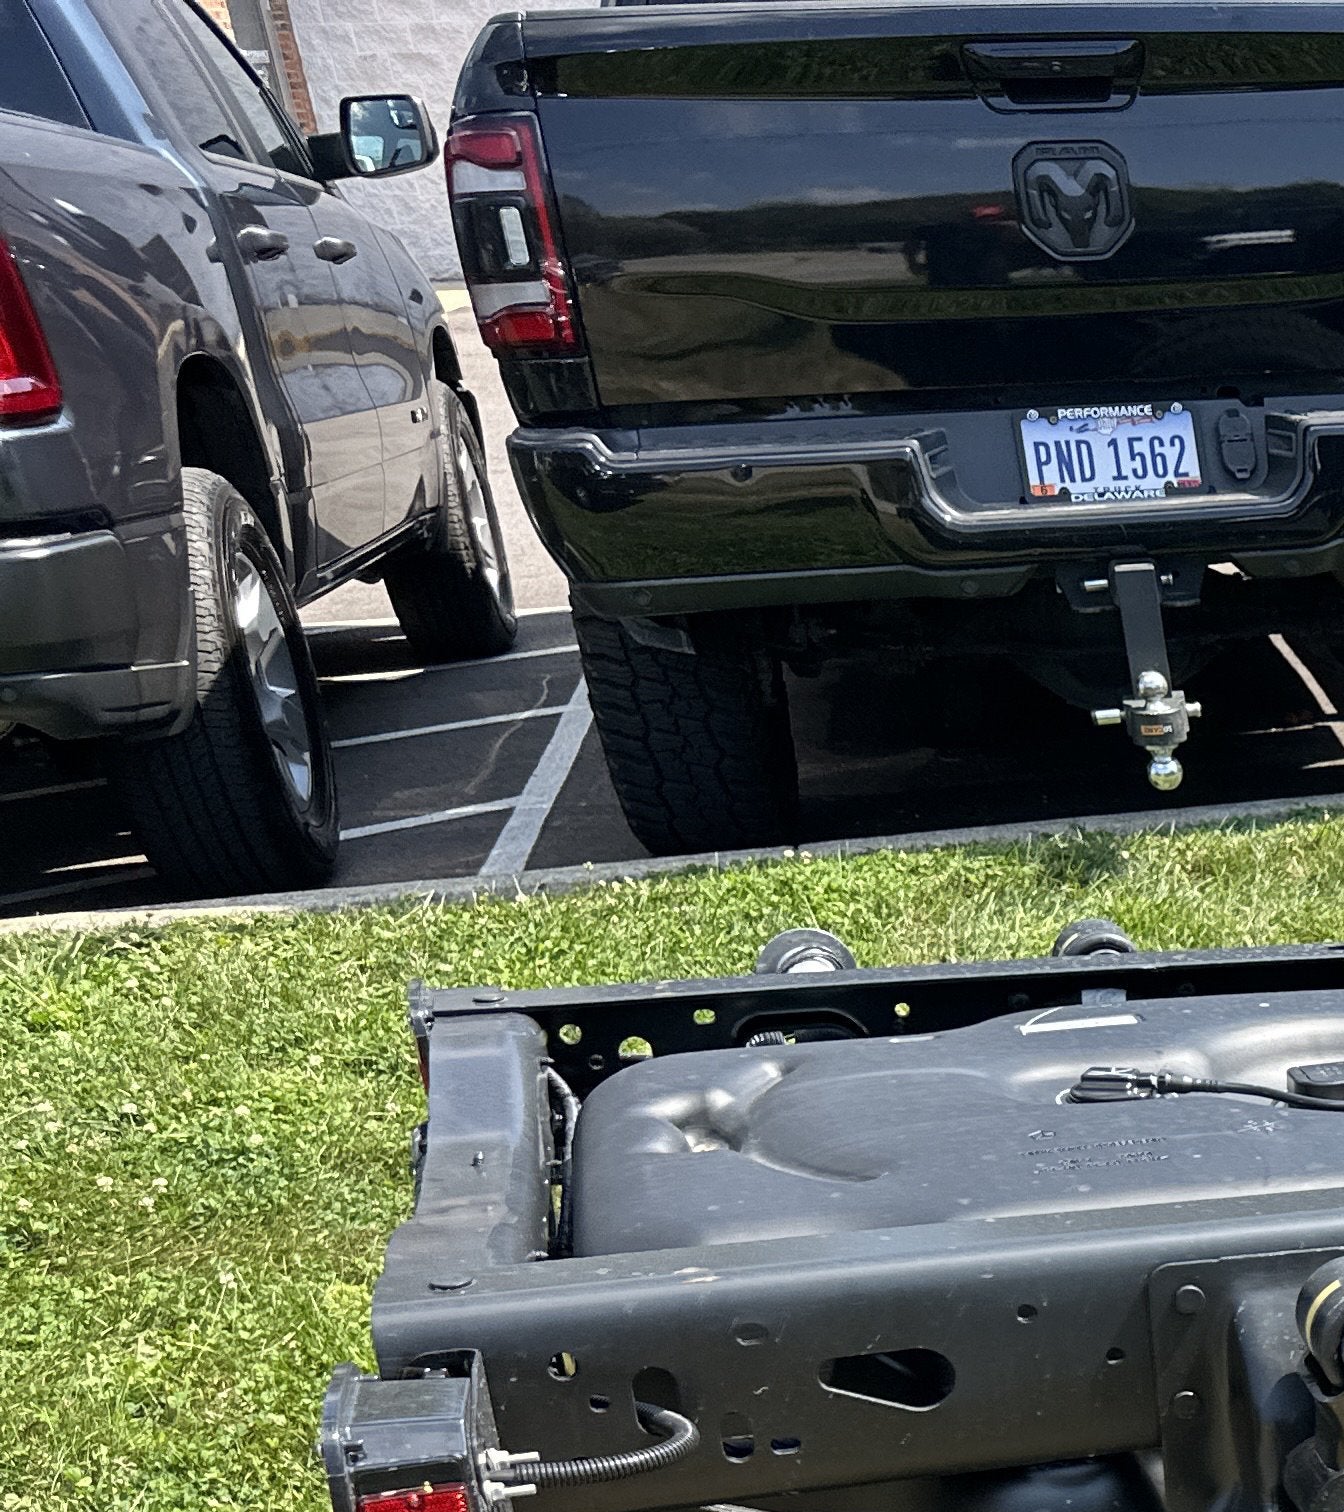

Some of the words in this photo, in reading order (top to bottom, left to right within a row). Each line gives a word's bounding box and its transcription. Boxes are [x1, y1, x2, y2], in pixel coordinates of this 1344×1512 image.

[1035, 145, 1101, 156] RAM
[1057, 403, 1153, 420] PERFORMANCE
[1033, 439, 1096, 486] PND
[1107, 434, 1190, 481] 1562
[1071, 488, 1166, 503] DELAWARE
